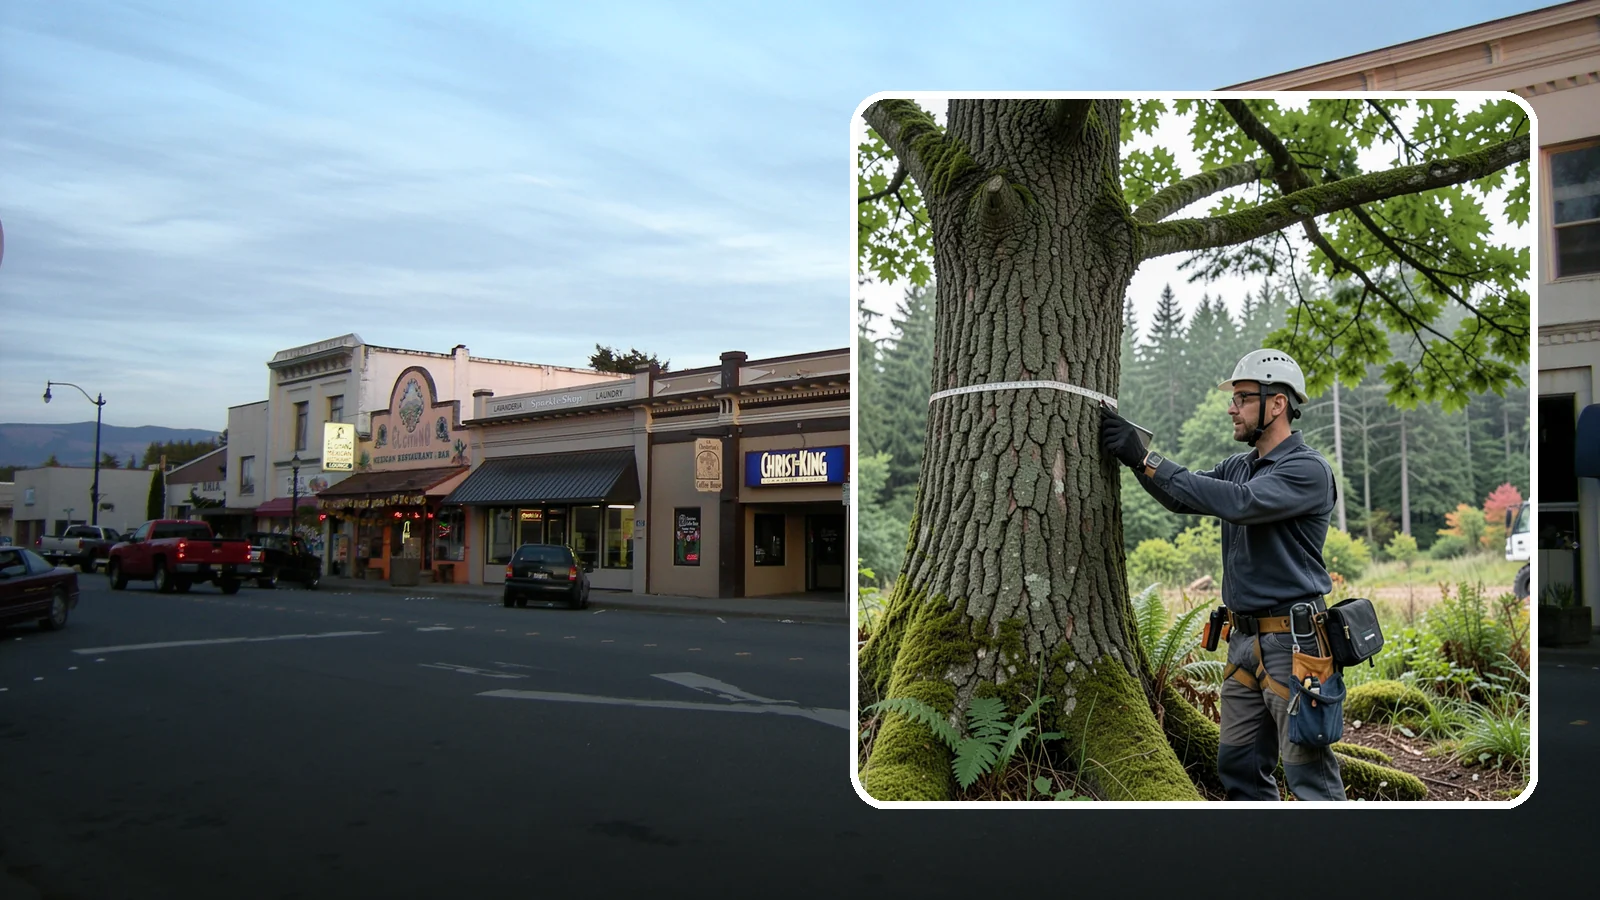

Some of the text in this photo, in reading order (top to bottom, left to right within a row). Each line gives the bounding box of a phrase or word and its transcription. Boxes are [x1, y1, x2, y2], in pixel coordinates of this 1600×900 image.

[596, 389, 623, 400] LAUNDRY
[494, 402, 522, 412] LAVANDERIA
[531, 394, 583, 409] Sparkle Shop
[374, 456, 396, 464] MEXICAN
[398, 452, 433, 462] RESTAURANT
[438, 451, 449, 459] BAR
[799, 450, 827, 476] KING
[696, 480, 709, 489] Coffee
